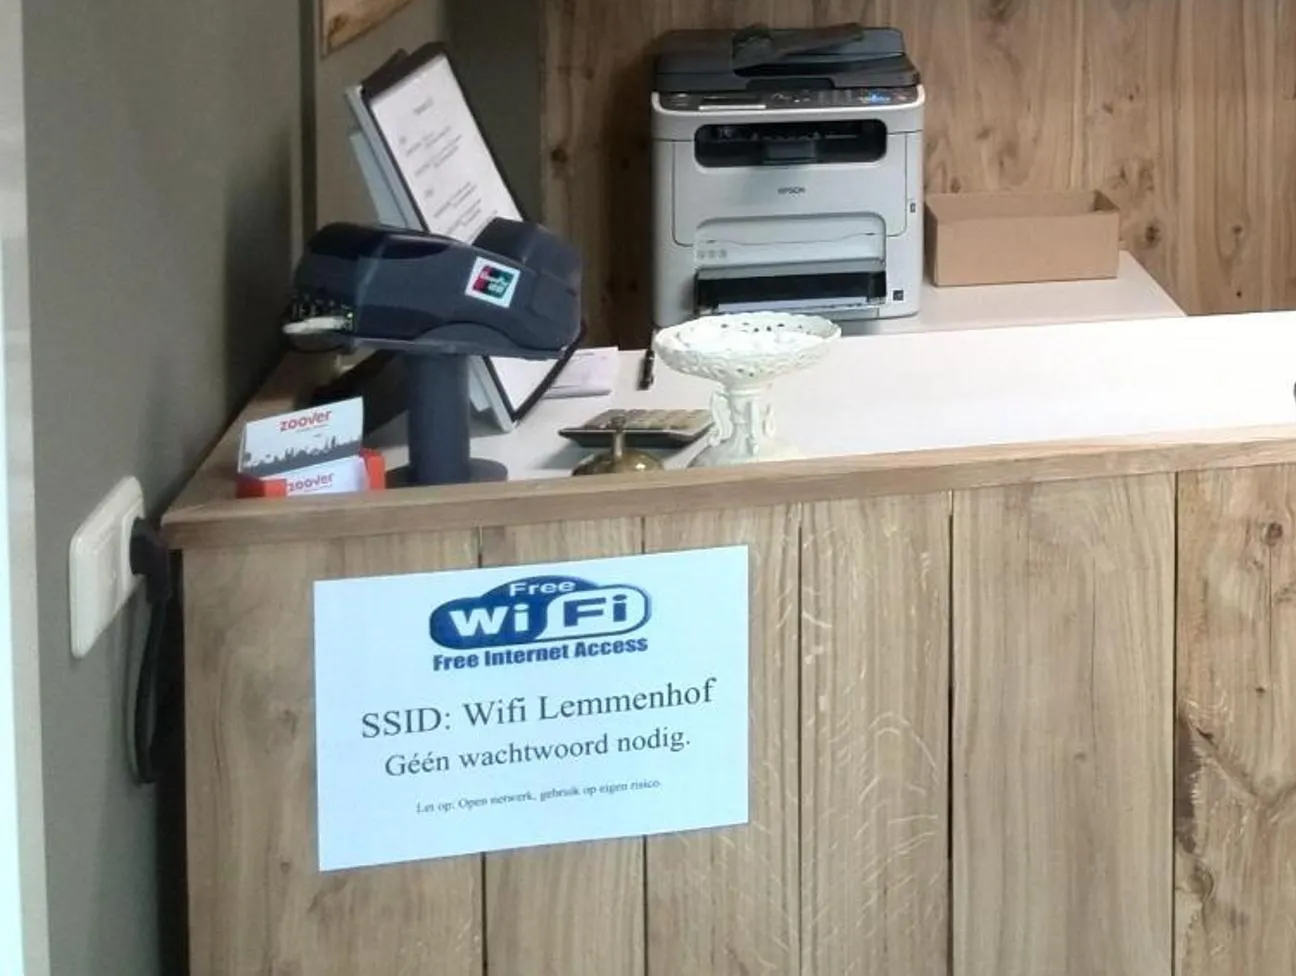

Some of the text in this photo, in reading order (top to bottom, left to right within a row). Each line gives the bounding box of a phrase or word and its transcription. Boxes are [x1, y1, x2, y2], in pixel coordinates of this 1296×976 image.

[509, 580, 576, 597] Free
[433, 636, 649, 671] Free Internet Access
[360, 676, 718, 740] SSID: Wifi Lemmenhof
[384, 726, 691, 778] Géén wachtwoord nodig.
[458, 795, 488, 811] Open
[582, 785, 597, 797] op
[598, 781, 628, 796] eigen
